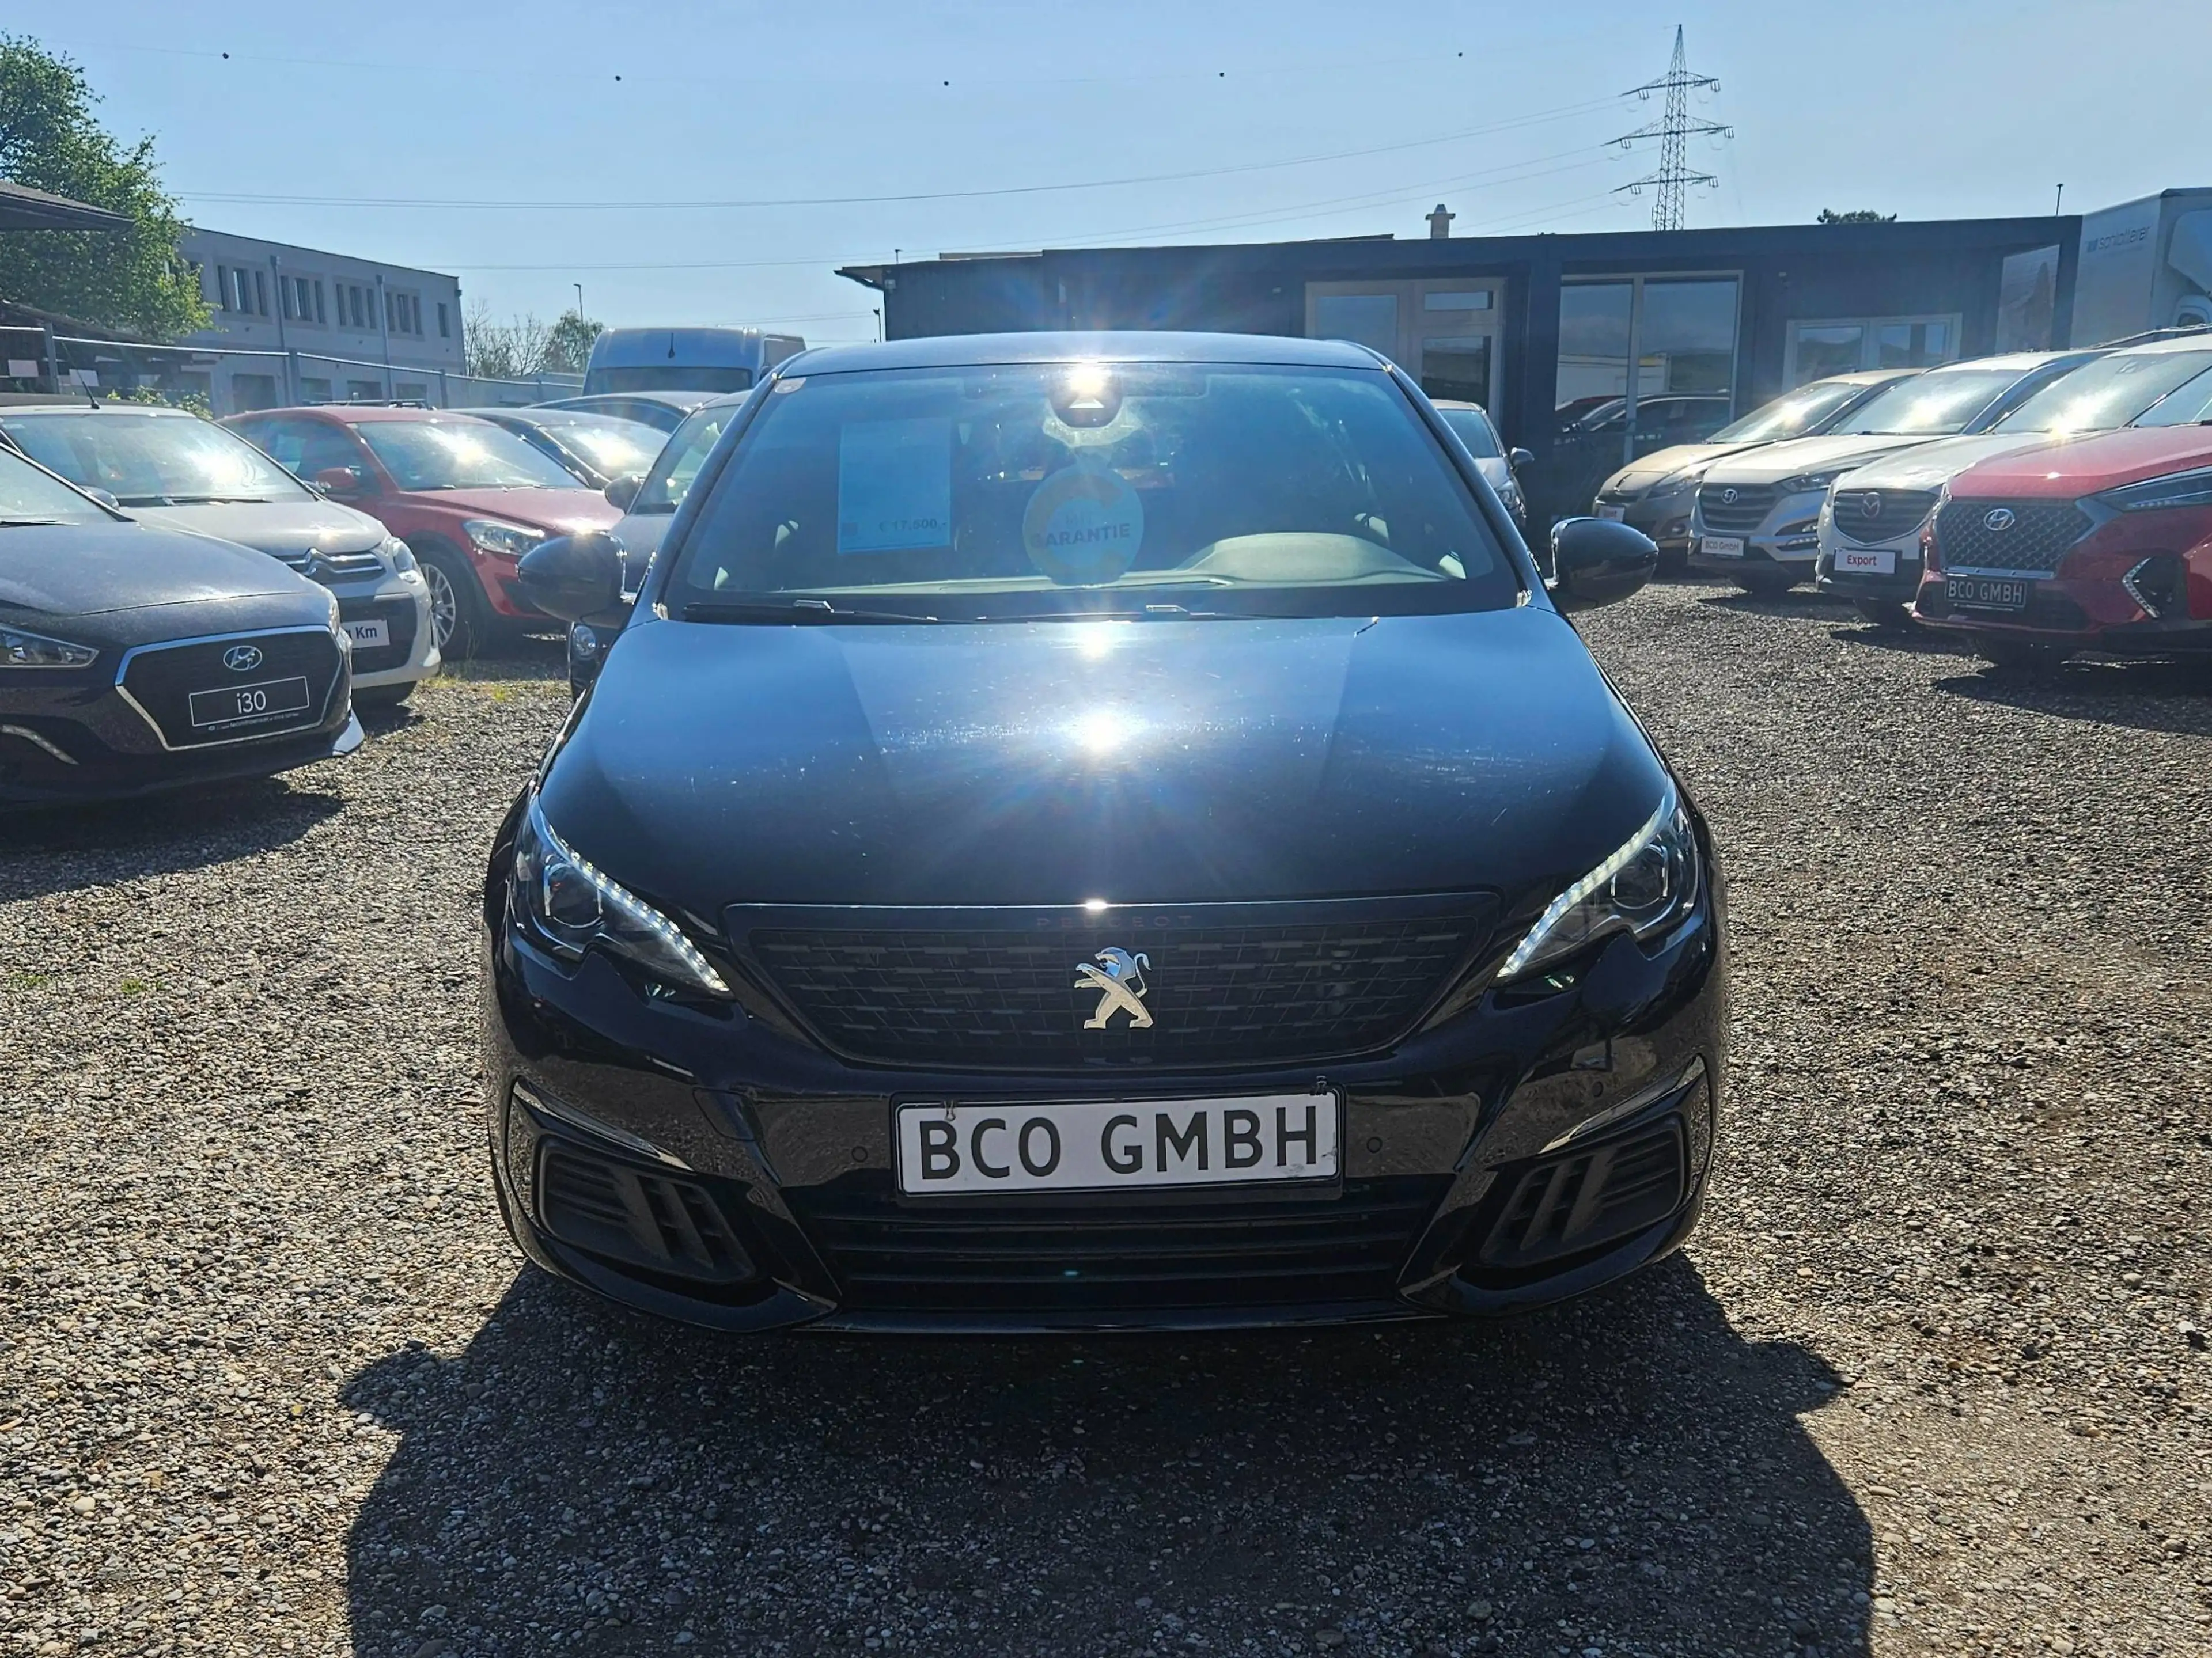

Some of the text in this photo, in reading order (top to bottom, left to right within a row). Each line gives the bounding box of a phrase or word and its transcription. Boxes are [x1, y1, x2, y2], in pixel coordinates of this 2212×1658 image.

[1029, 523, 1130, 549] GARANTIE
[1847, 555, 1877, 567] Export
[1948, 579, 2023, 604] BCO GMBH
[355, 626, 377, 639] Km
[237, 690, 266, 714] i30
[1036, 915, 1193, 928] PEUGEOT
[920, 1106, 1317, 1180] BCO GMBH
